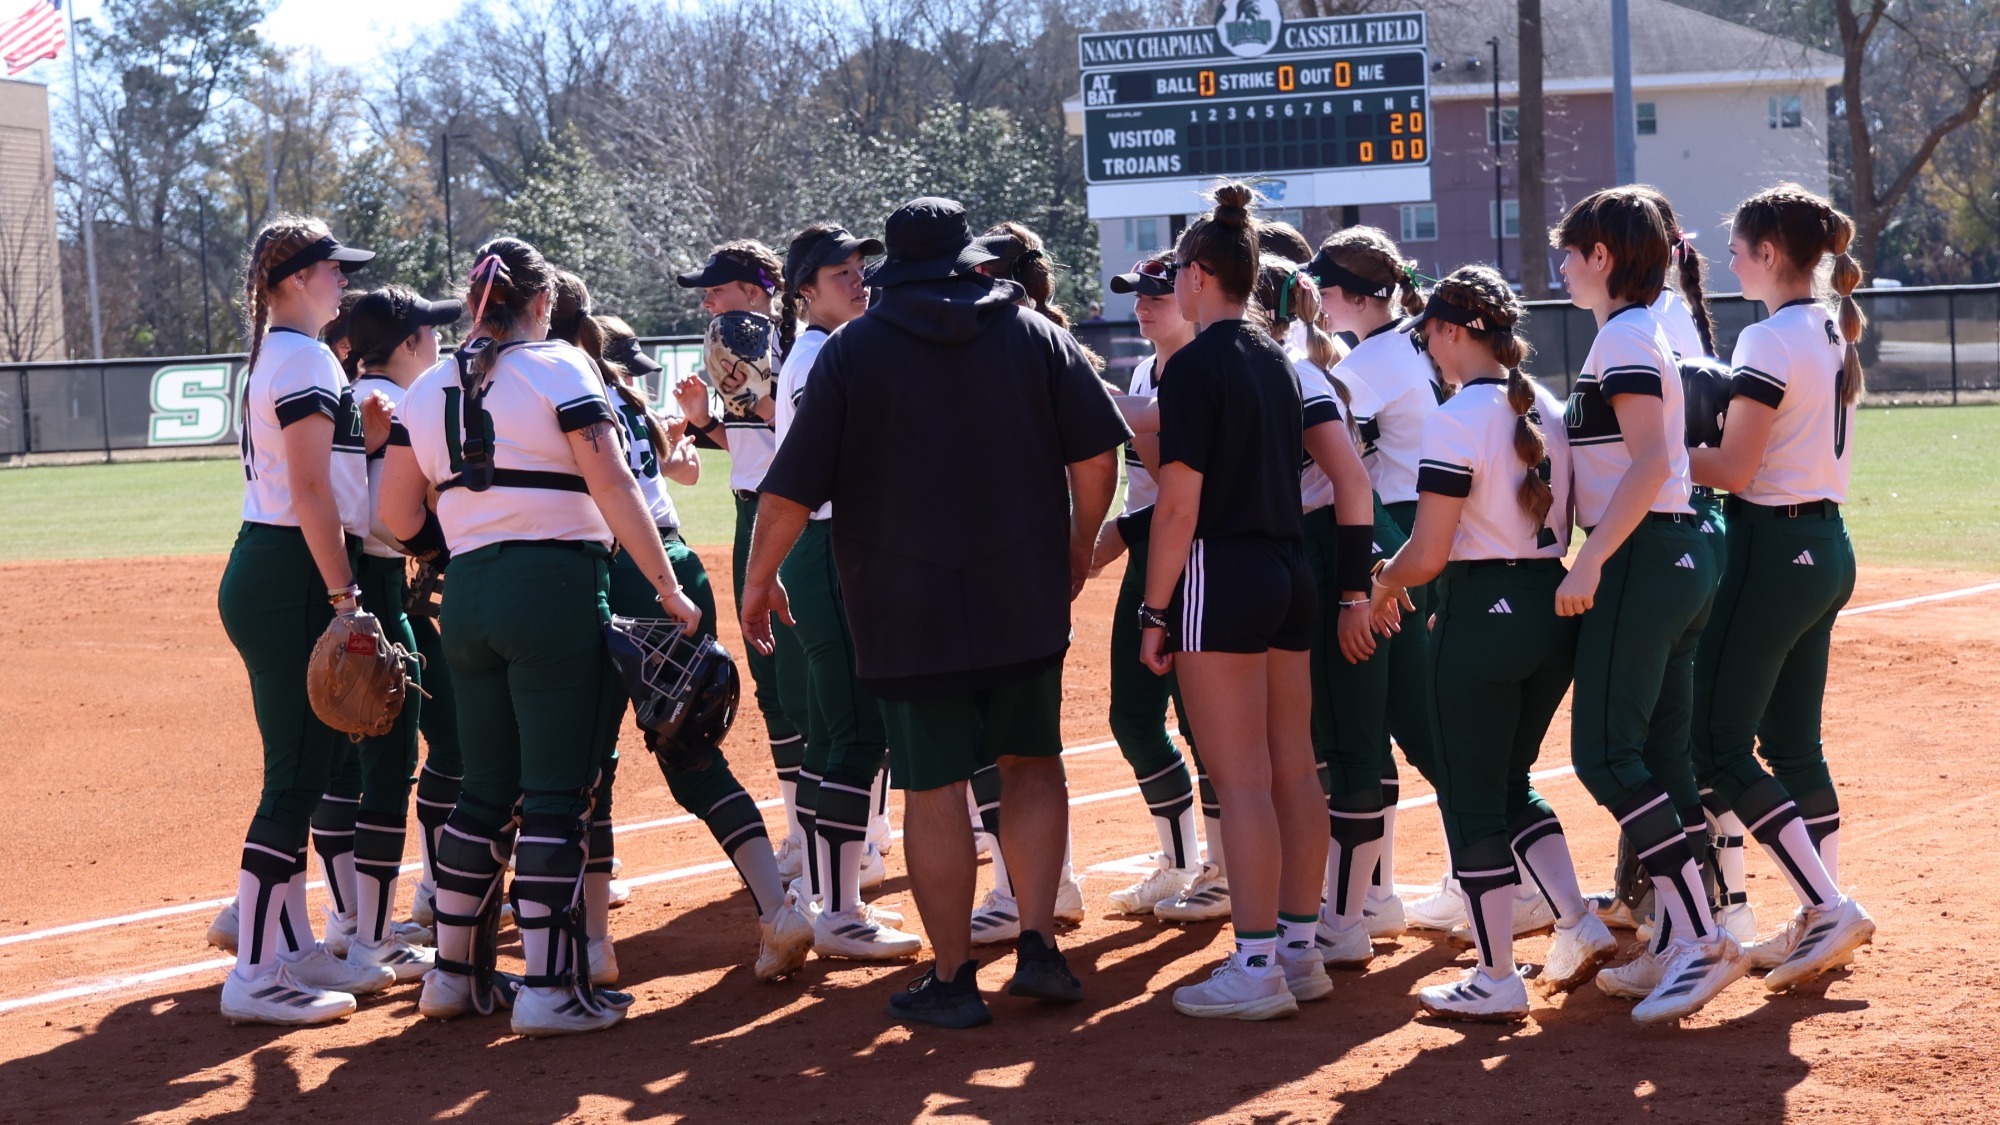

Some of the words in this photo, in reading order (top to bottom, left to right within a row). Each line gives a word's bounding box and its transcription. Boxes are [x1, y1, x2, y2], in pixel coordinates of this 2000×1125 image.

[1084, 39, 1135, 62] NANCY
[1137, 33, 1214, 58] CHAPMAN
[1285, 23, 1362, 49] CASSELL
[1366, 20, 1420, 43] FIELD
[1092, 75, 1112, 90] AT
[1156, 77, 1196, 94] BALL
[1199, 70, 1216, 97] 0
[1219, 71, 1275, 90] STRIKE
[1278, 65, 1295, 92] 0
[1300, 68, 1332, 85] OUT
[1335, 61, 1351, 87] 0
[1358, 64, 1385, 81] H/E
[1087, 89, 1117, 106] BAT
[1190, 110, 1198, 123] 1
[1208, 108, 1218, 121] 2
[1227, 107, 1237, 120] 3
[1246, 106, 1256, 119] 4
[1265, 105, 1275, 118] 5
[1284, 104, 1294, 117] 6
[1303, 102, 1313, 116] 7
[1323, 101, 1332, 115] 8
[1352, 99, 1362, 112] R
[1384, 97, 1394, 110] H
[1410, 95, 1419, 109] E
[1108, 128, 1176, 149] VISITOR
[1102, 155, 1182, 175] TROJANS
[1360, 141, 1373, 162] 0
